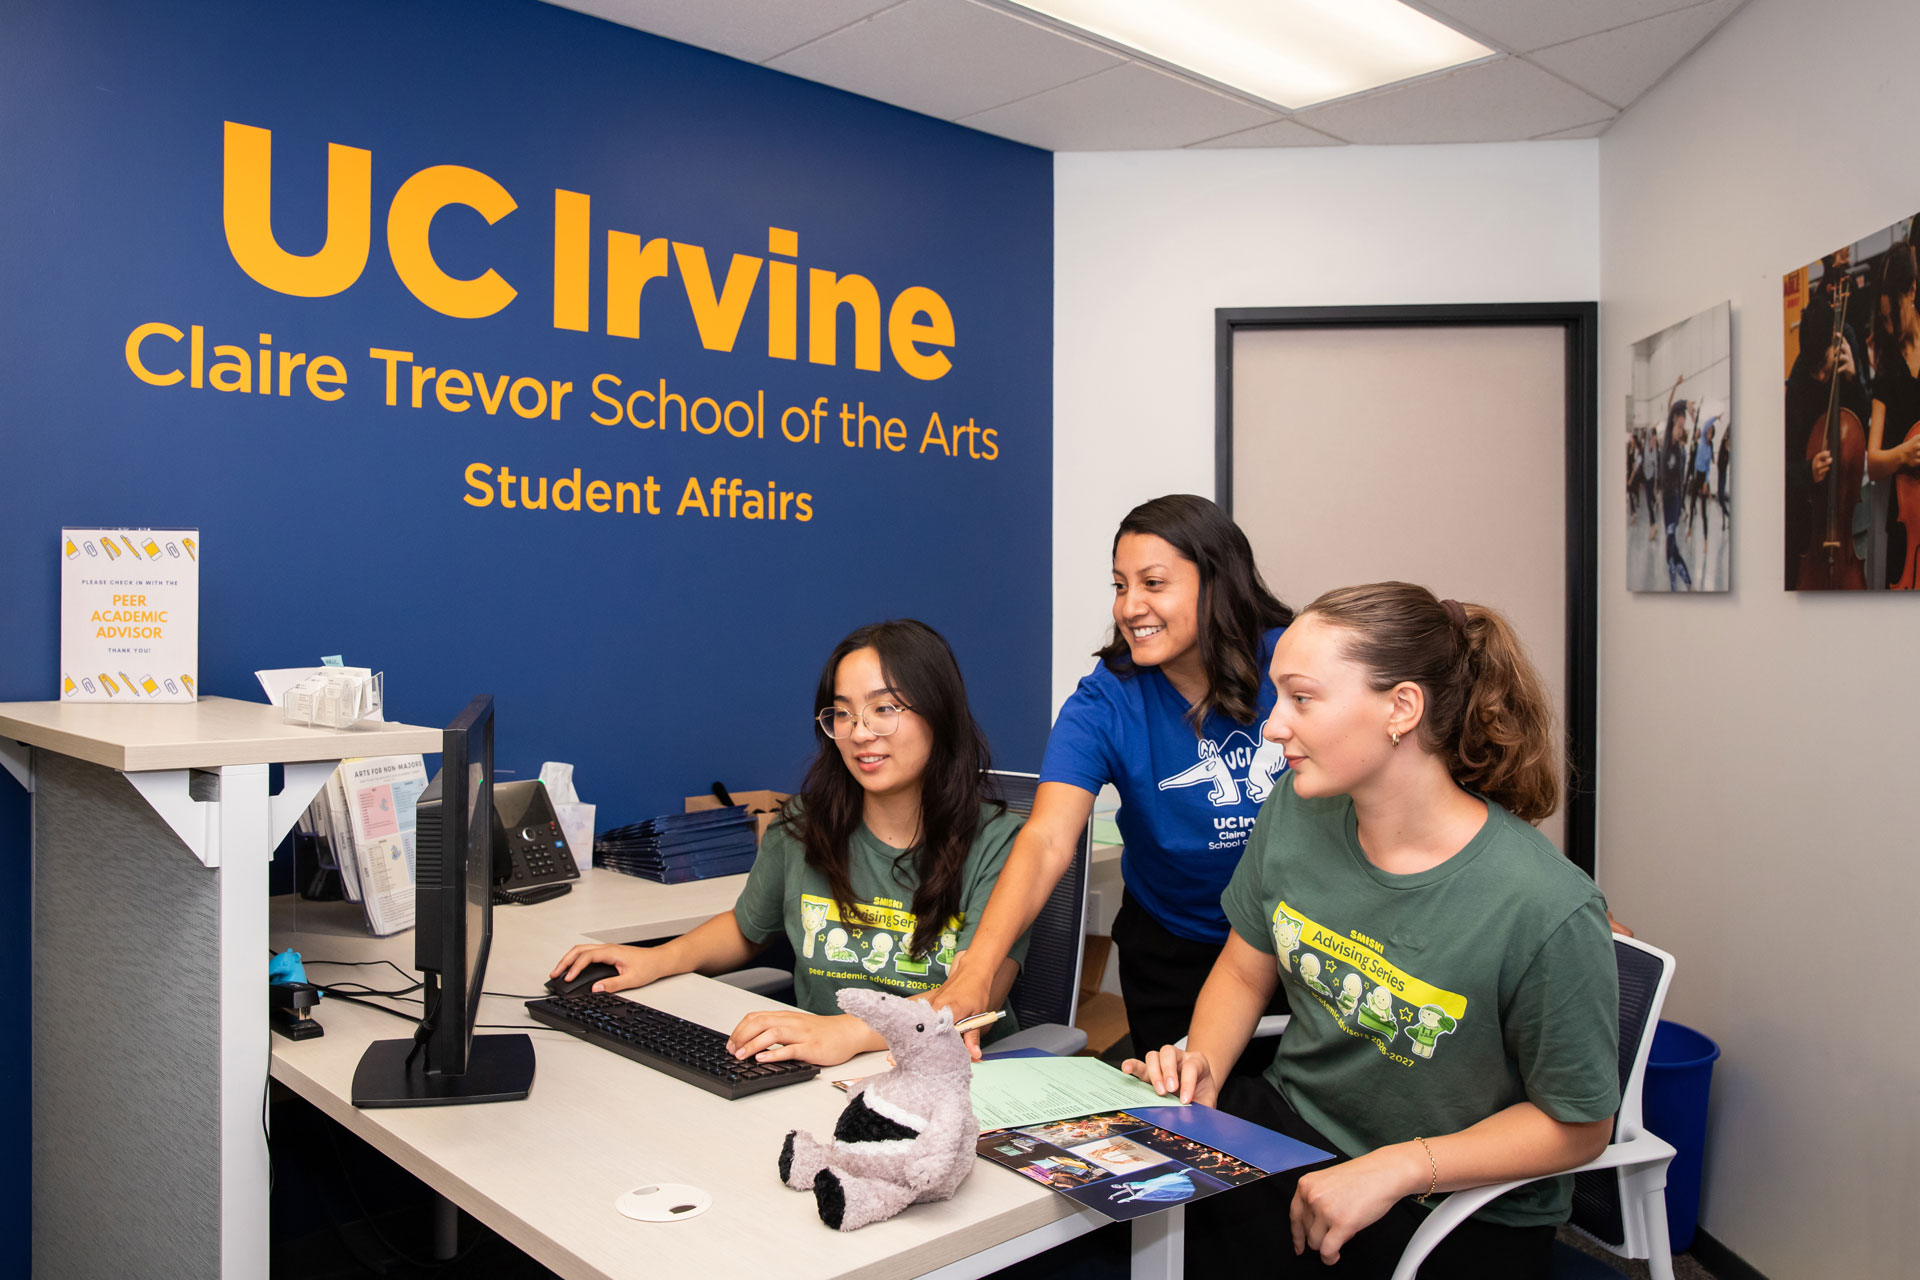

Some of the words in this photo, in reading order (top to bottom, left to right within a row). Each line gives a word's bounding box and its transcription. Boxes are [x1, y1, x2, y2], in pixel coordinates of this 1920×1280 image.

[223, 120, 519, 319] UC
[553, 188, 956, 381] Irvine
[125, 322, 348, 402] Claire
[369, 347, 573, 421] Trevor
[590, 373, 764, 439] School
[780, 396, 828, 443] of
[839, 401, 908, 452] the
[919, 411, 999, 461] Arts
[463, 462, 662, 516] Student
[676, 477, 813, 522] Affairs
[112, 594, 147, 606] PEER
[90, 610, 168, 623] ACADEMIC
[96, 626, 162, 639] ADVISOR
[1224, 746, 1252, 770] UCI
[354, 769, 371, 778] ARTS
[372, 767, 382, 775] FOR
[1214, 817, 1238, 830] UC
[1238, 816, 1257, 828] Irv
[1218, 830, 1246, 840] Claire
[1208, 840, 1240, 850] School
[873, 896, 903, 909] SMISKI
[892, 914, 918, 930] Seri
[1349, 929, 1385, 954] SMISKI
[1312, 930, 1370, 971] Advising
[1369, 959, 1406, 992] Series
[808, 968, 824, 976] peer
[826, 970, 868, 980] academic
[870, 976, 905, 988] advisors
[906, 980, 942, 990] 2026-20
[1371, 1035, 1415, 1068] 2026-2027
